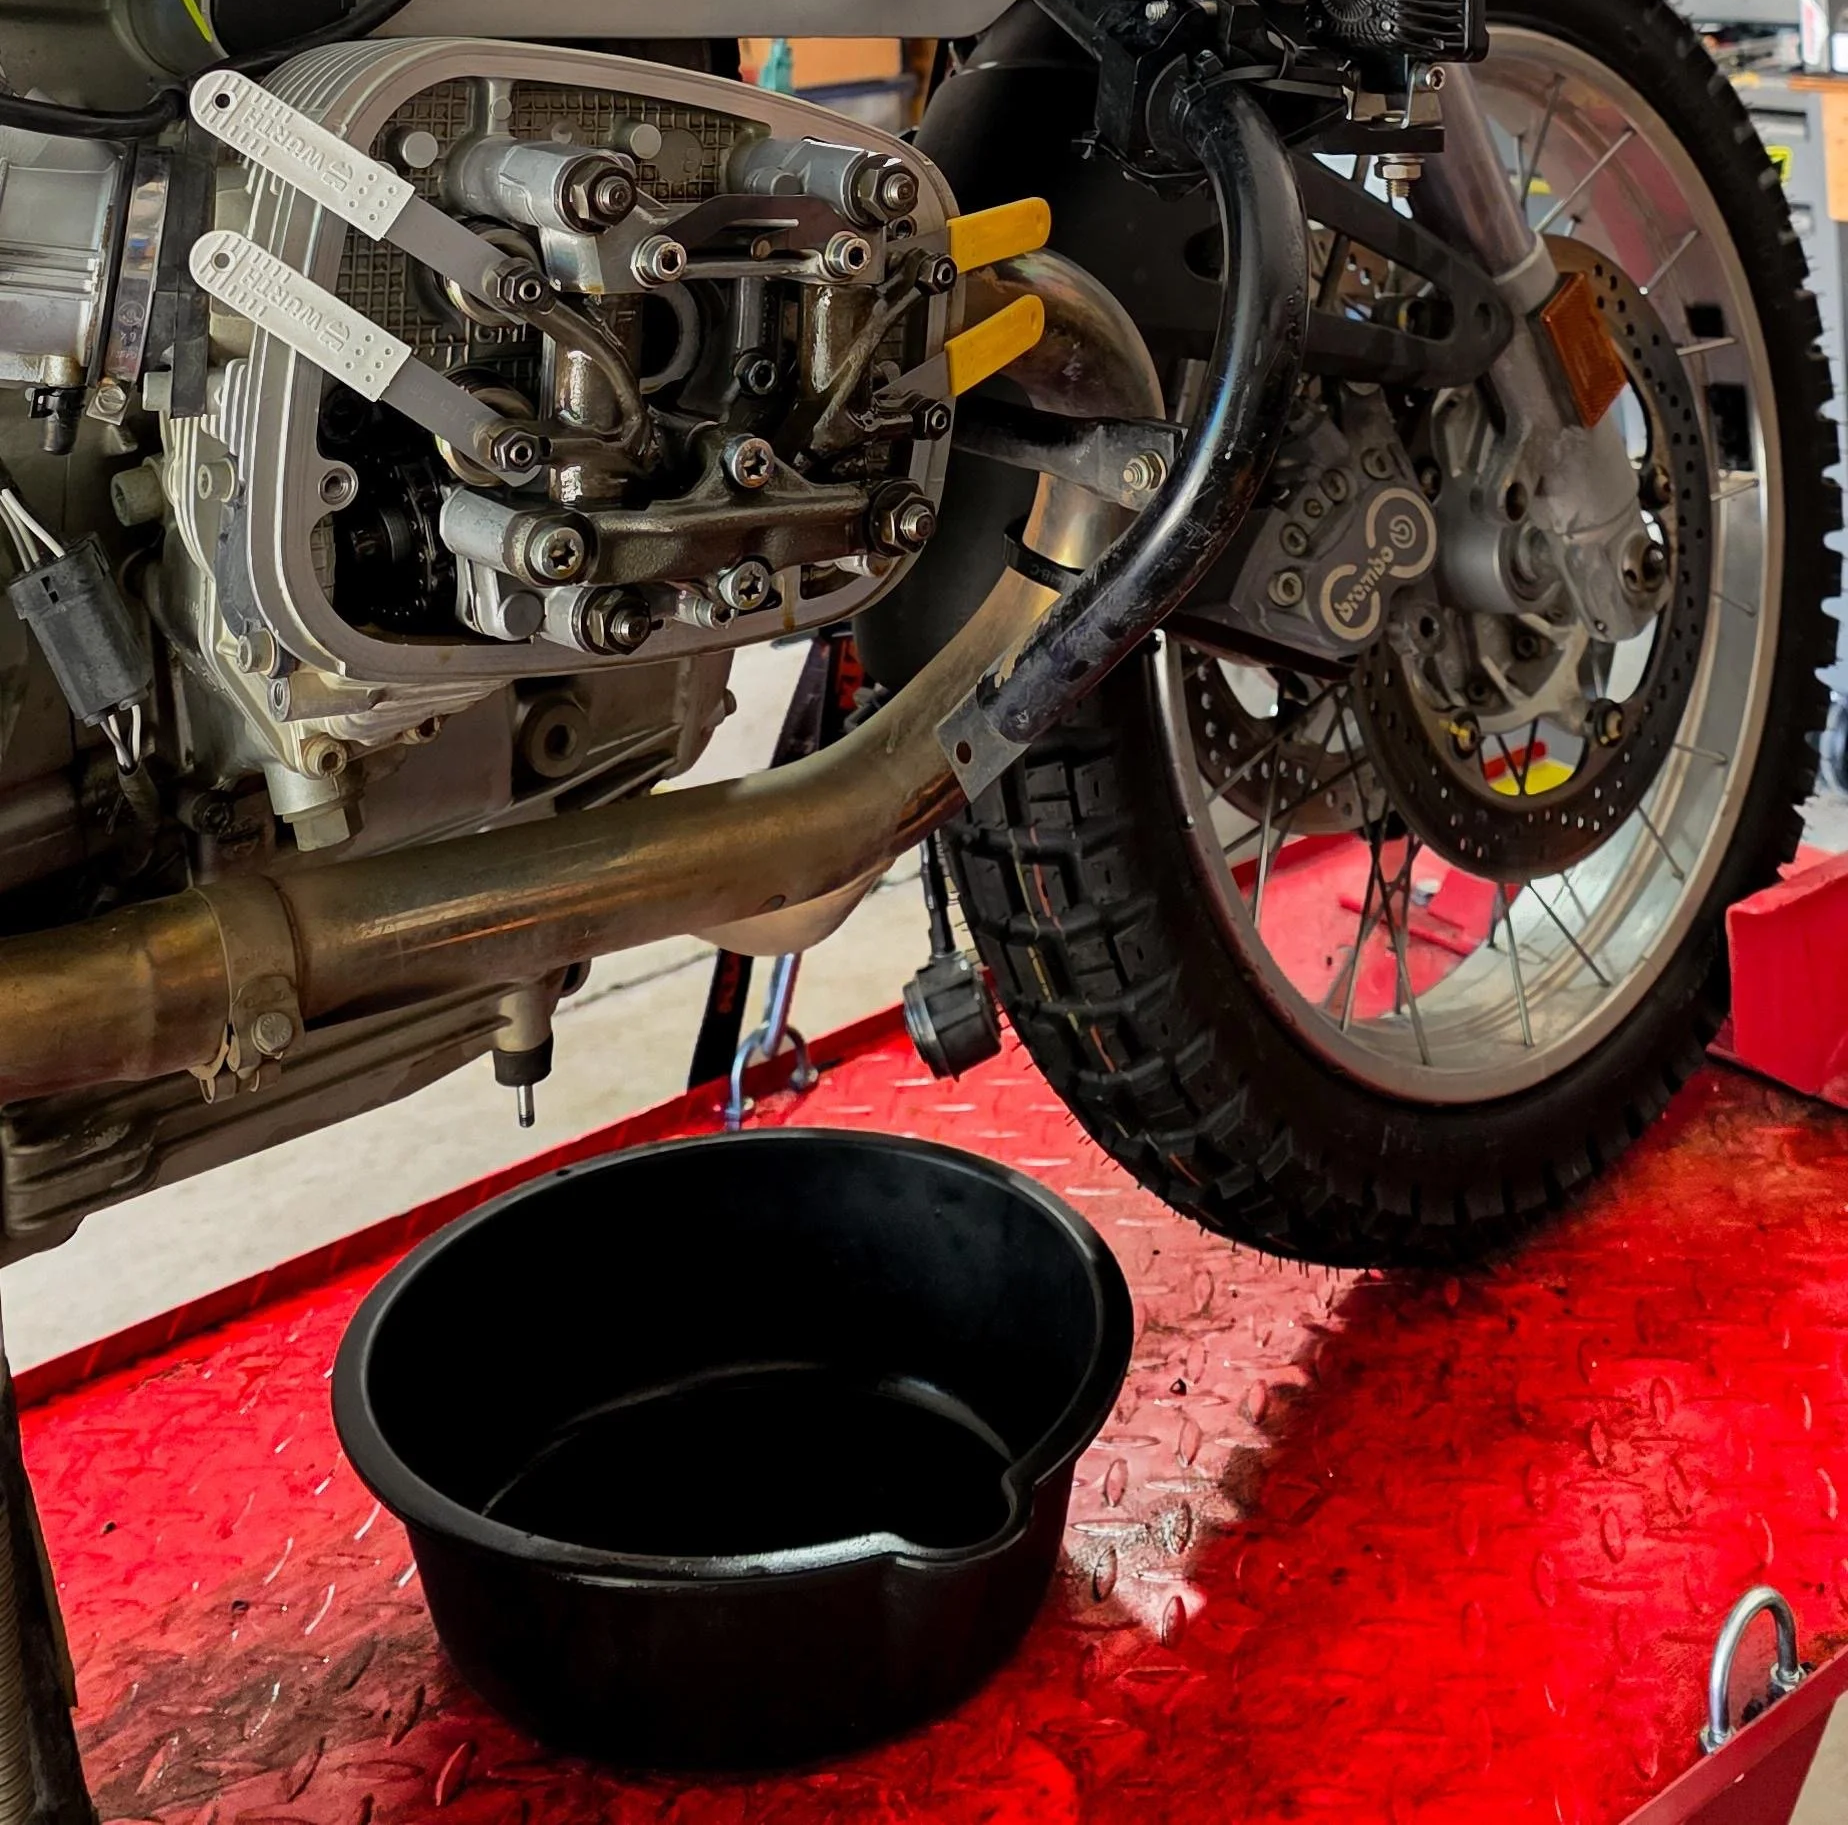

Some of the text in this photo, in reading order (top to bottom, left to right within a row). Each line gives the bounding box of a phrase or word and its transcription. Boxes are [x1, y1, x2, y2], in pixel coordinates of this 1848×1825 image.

[240, 107, 325, 172] WÜRTH
[239, 267, 323, 331] WÜRTH
[1333, 545, 1395, 623] brembo
